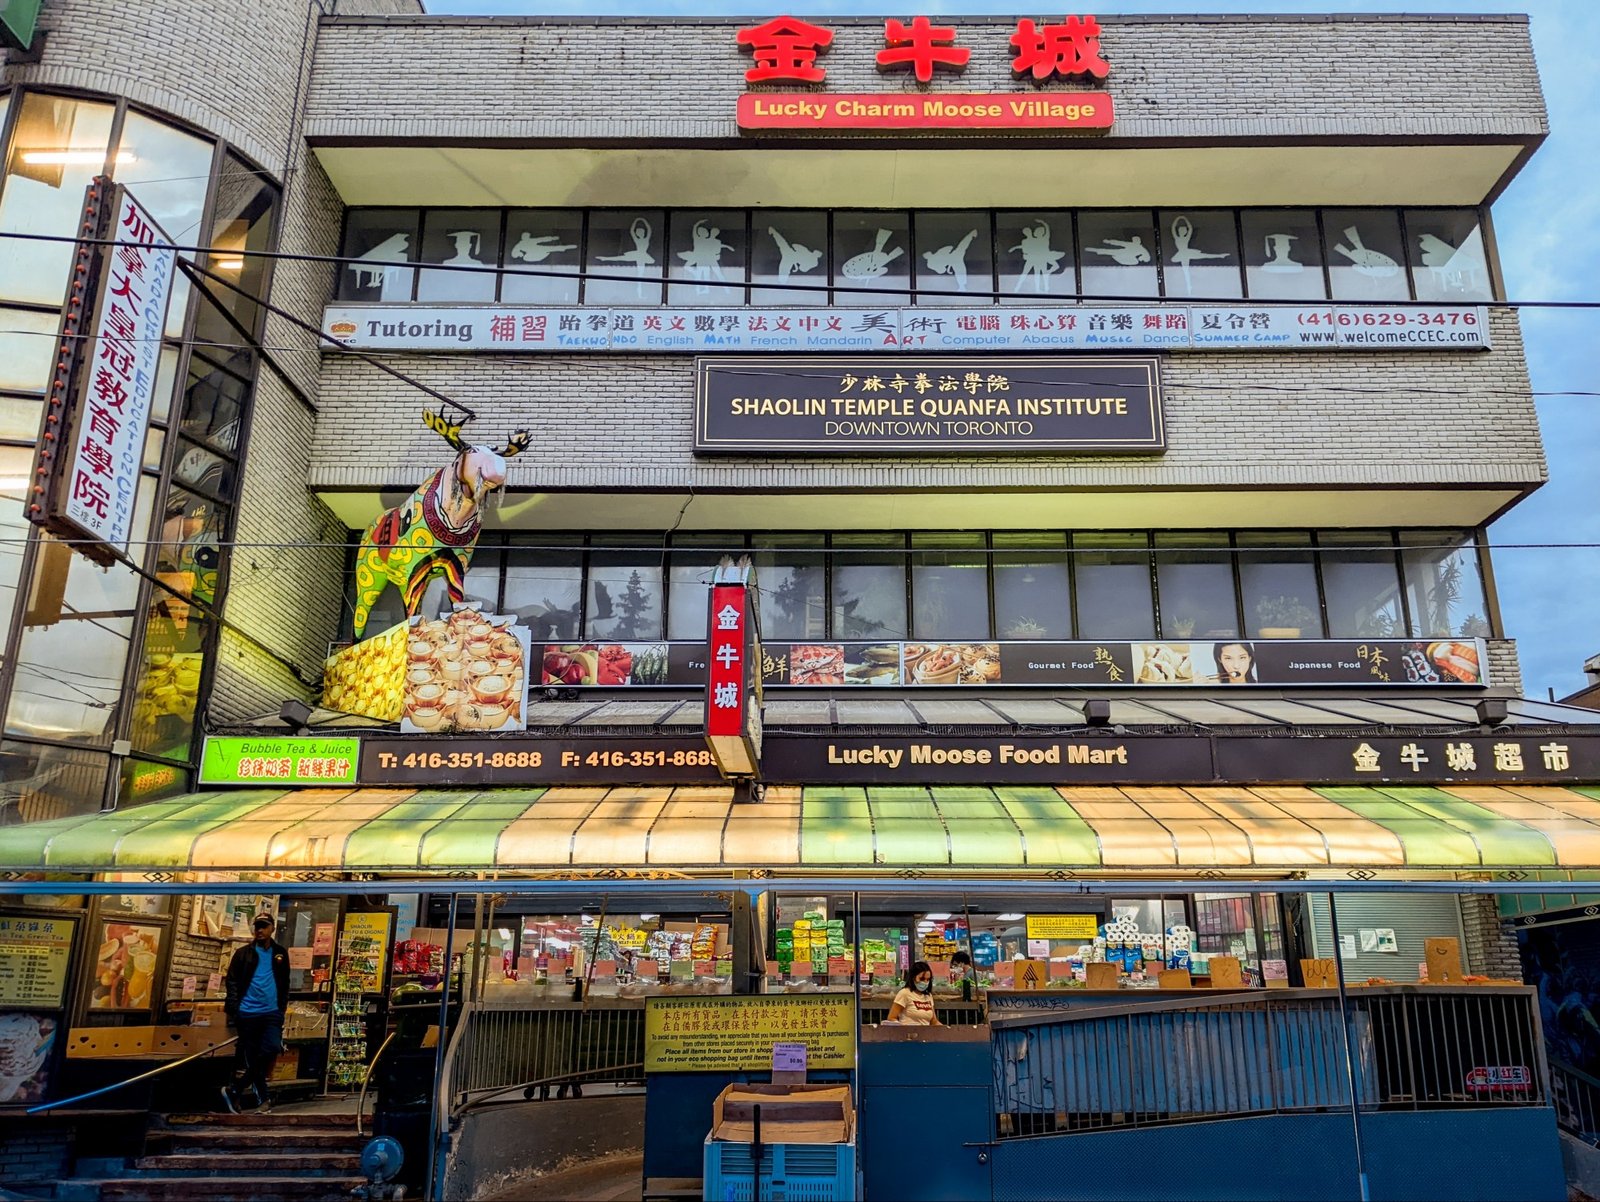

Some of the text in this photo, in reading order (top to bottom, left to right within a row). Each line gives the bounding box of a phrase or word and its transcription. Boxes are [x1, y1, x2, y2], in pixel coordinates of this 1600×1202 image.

[736, 15, 1111, 84] 金牛城
[754, 99, 1096, 121] Lucky Charm Moose Village
[367, 312, 1476, 342] Tutoring 補習 跆拳道 英文 數學 法文 中文 美術 電腦 珠心算 音樂 舞蹈 夏令營 (416)629-3476
[647, 335, 694, 346] English
[751, 335, 797, 345] French
[807, 335, 872, 346] Mandarin
[883, 332, 928, 346] ART
[942, 335, 1011, 346] Computer
[1022, 334, 1074, 344] Abacus
[1143, 333, 1188, 344] Dance
[1193, 333, 1251, 343] SUMMER
[1254, 333, 1290, 343] CAMP
[1299, 329, 1480, 343] www.welcomeCCEC.com
[840, 371, 1010, 395] 少林寺拳法學院
[731, 397, 1128, 417] SHAOLIN TEMPLE QUANFA INSTITUTE
[121, 369, 148, 478] EDUCATION
[825, 421, 1033, 436] DOWNTOWN TORONTO
[688, 661, 705, 669] Fre
[714, 604, 741, 708] 金牛城
[1028, 661, 1094, 669] Gourmet Food
[1092, 646, 1125, 682] 熟食
[1289, 661, 1360, 670] Japanese Food
[241, 744, 352, 754] Bubble Tea & Juice
[828, 745, 1128, 768] Lucky Moose Food Mart
[1352, 742, 1569, 773] 金牛城超市
[379, 752, 542, 768] T: 416-351-8688
[561, 752, 580, 767] F:
[700, 1055, 726, 1063] shopping
